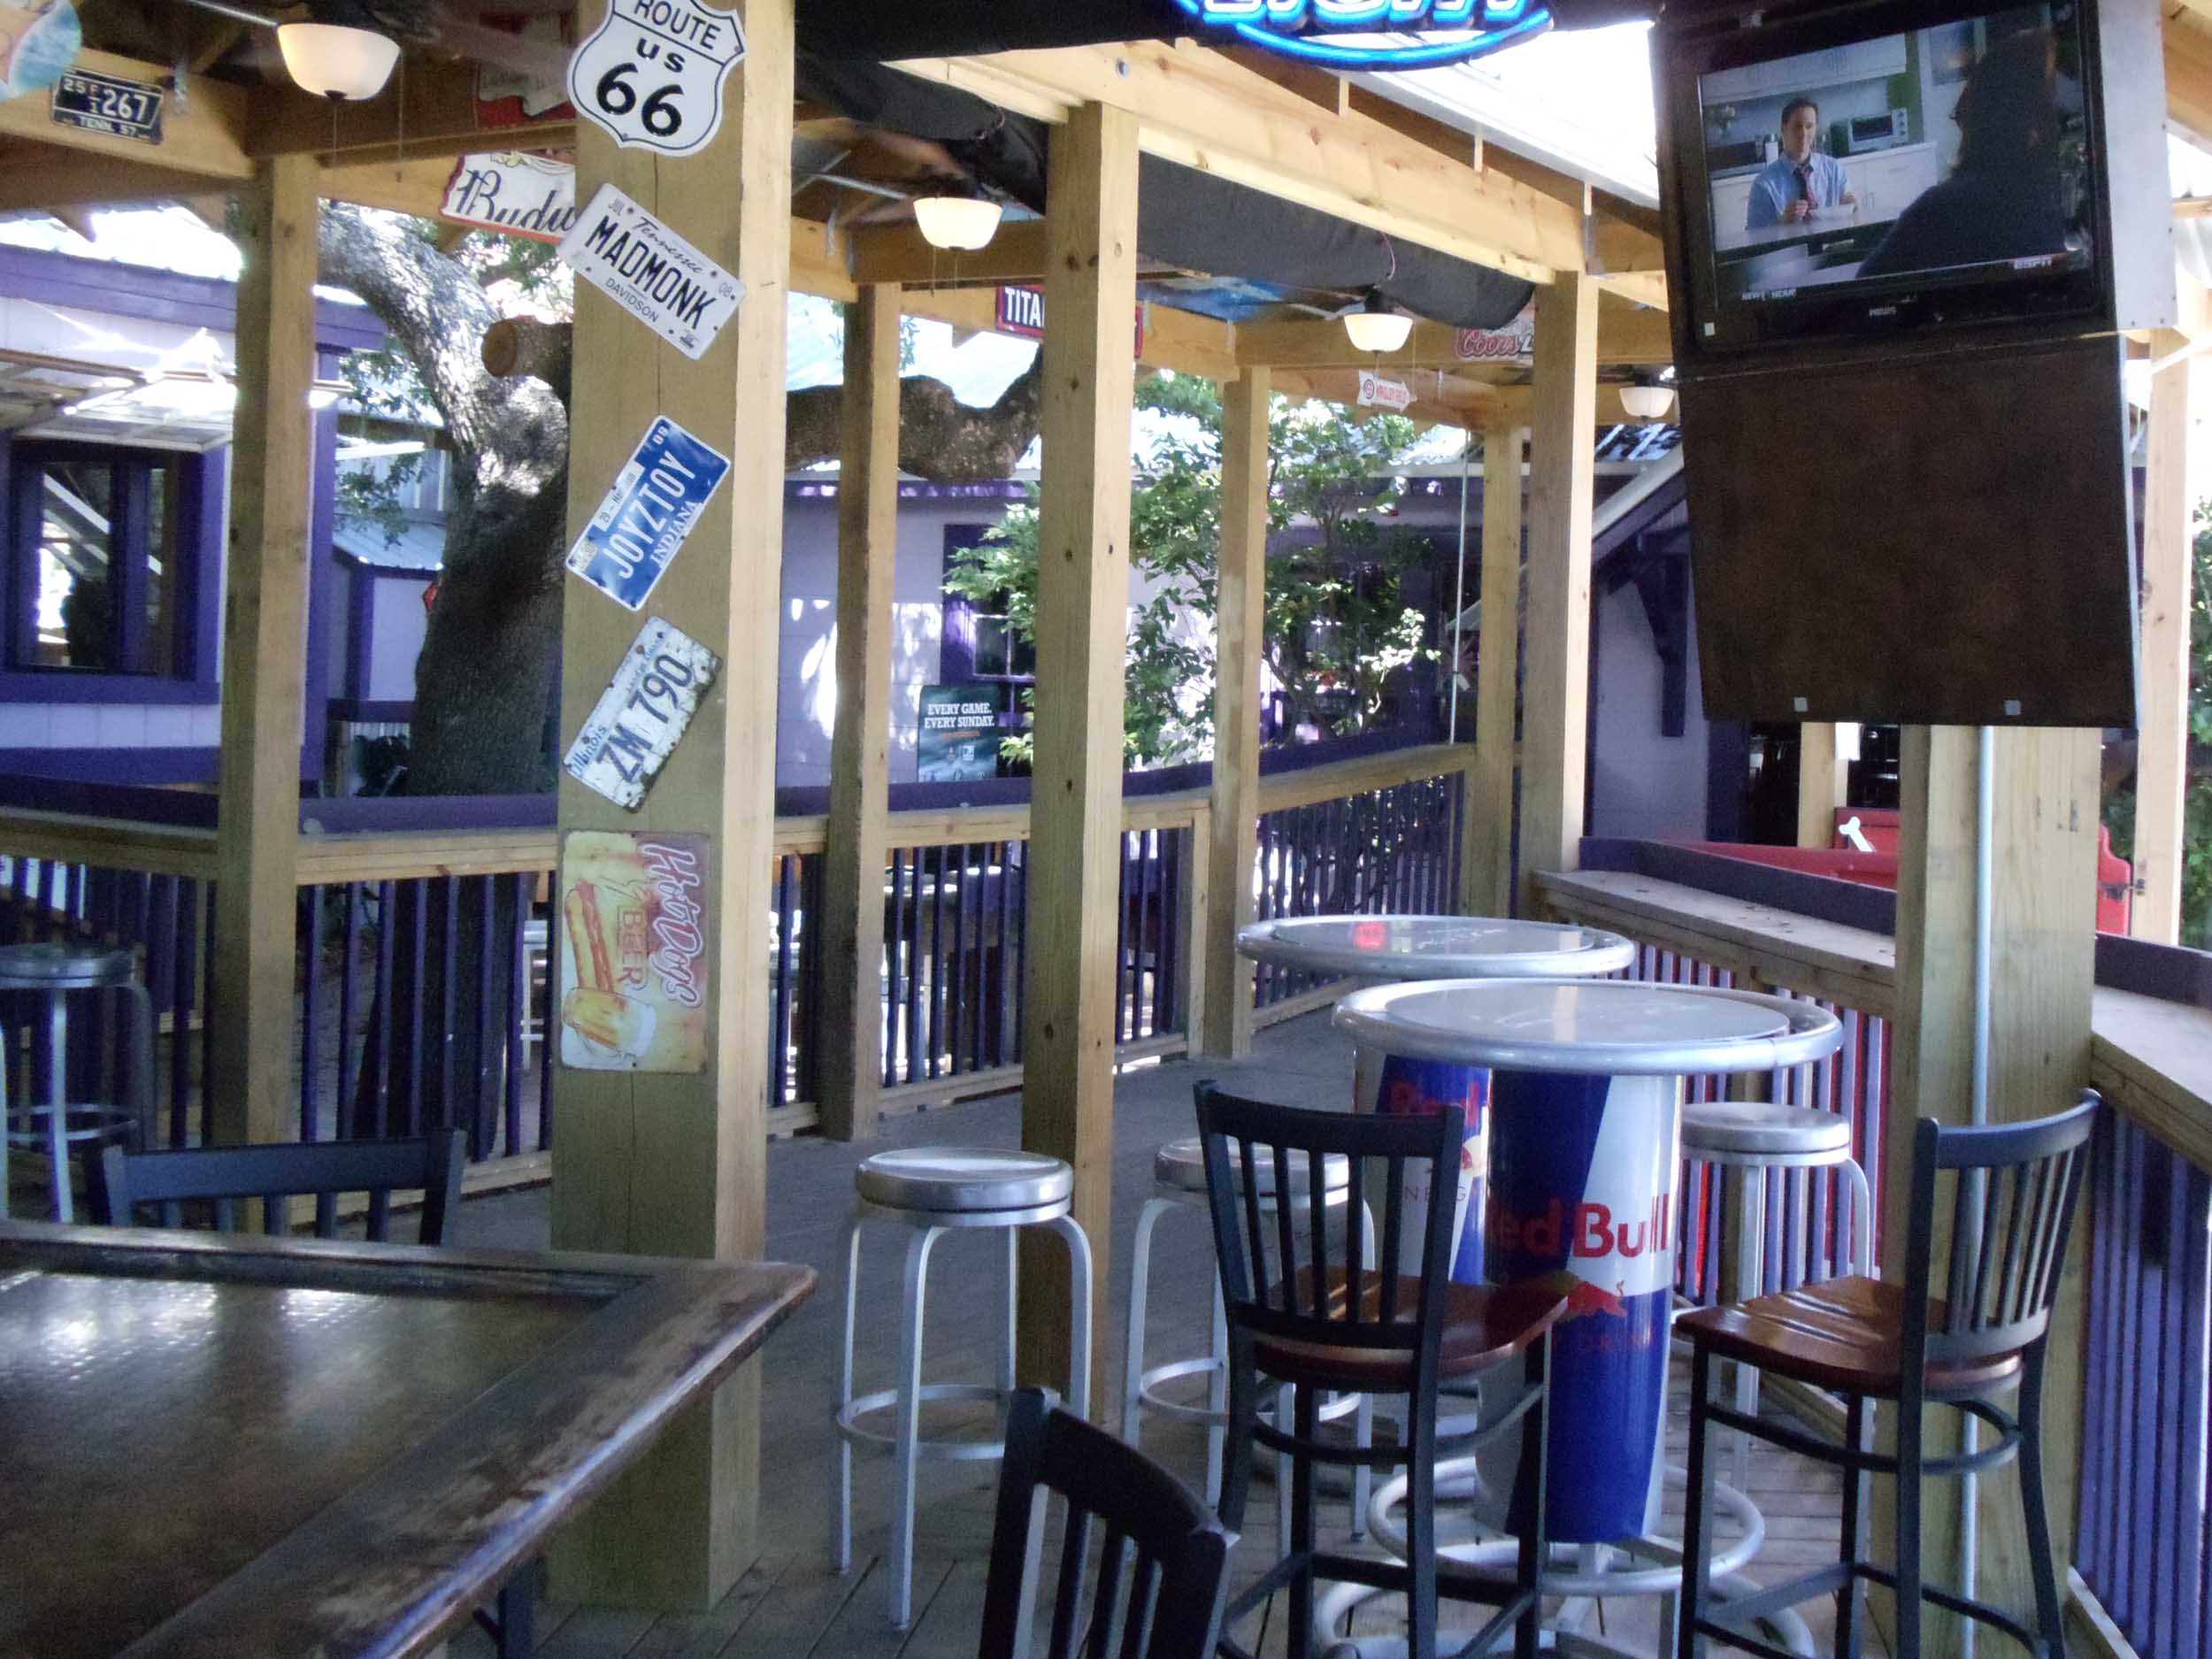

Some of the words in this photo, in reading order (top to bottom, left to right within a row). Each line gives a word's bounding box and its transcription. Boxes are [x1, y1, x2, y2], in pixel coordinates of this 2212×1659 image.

[634, 0, 721, 50] ROUTE
[636, 37, 686, 73] US
[102, 88, 149, 122] 267
[596, 62, 684, 137] 66
[631, 216, 704, 274] Tennessee
[584, 214, 718, 331] MADMONK
[604, 277, 659, 323] DAVIDSON
[1004, 286, 1046, 328] TITA
[1460, 328, 1519, 356] Coors
[603, 450, 696, 580] JOYZTOY
[649, 499, 703, 565] INDIANA
[596, 722, 654, 783] ZM
[627, 654, 693, 724] 790
[924, 717, 956, 729] EVERY
[956, 715, 995, 727] SUNDAY.
[927, 703, 960, 716] EVERY
[961, 702, 993, 714] GAME.
[1571, 1194, 1671, 1259] Bull
